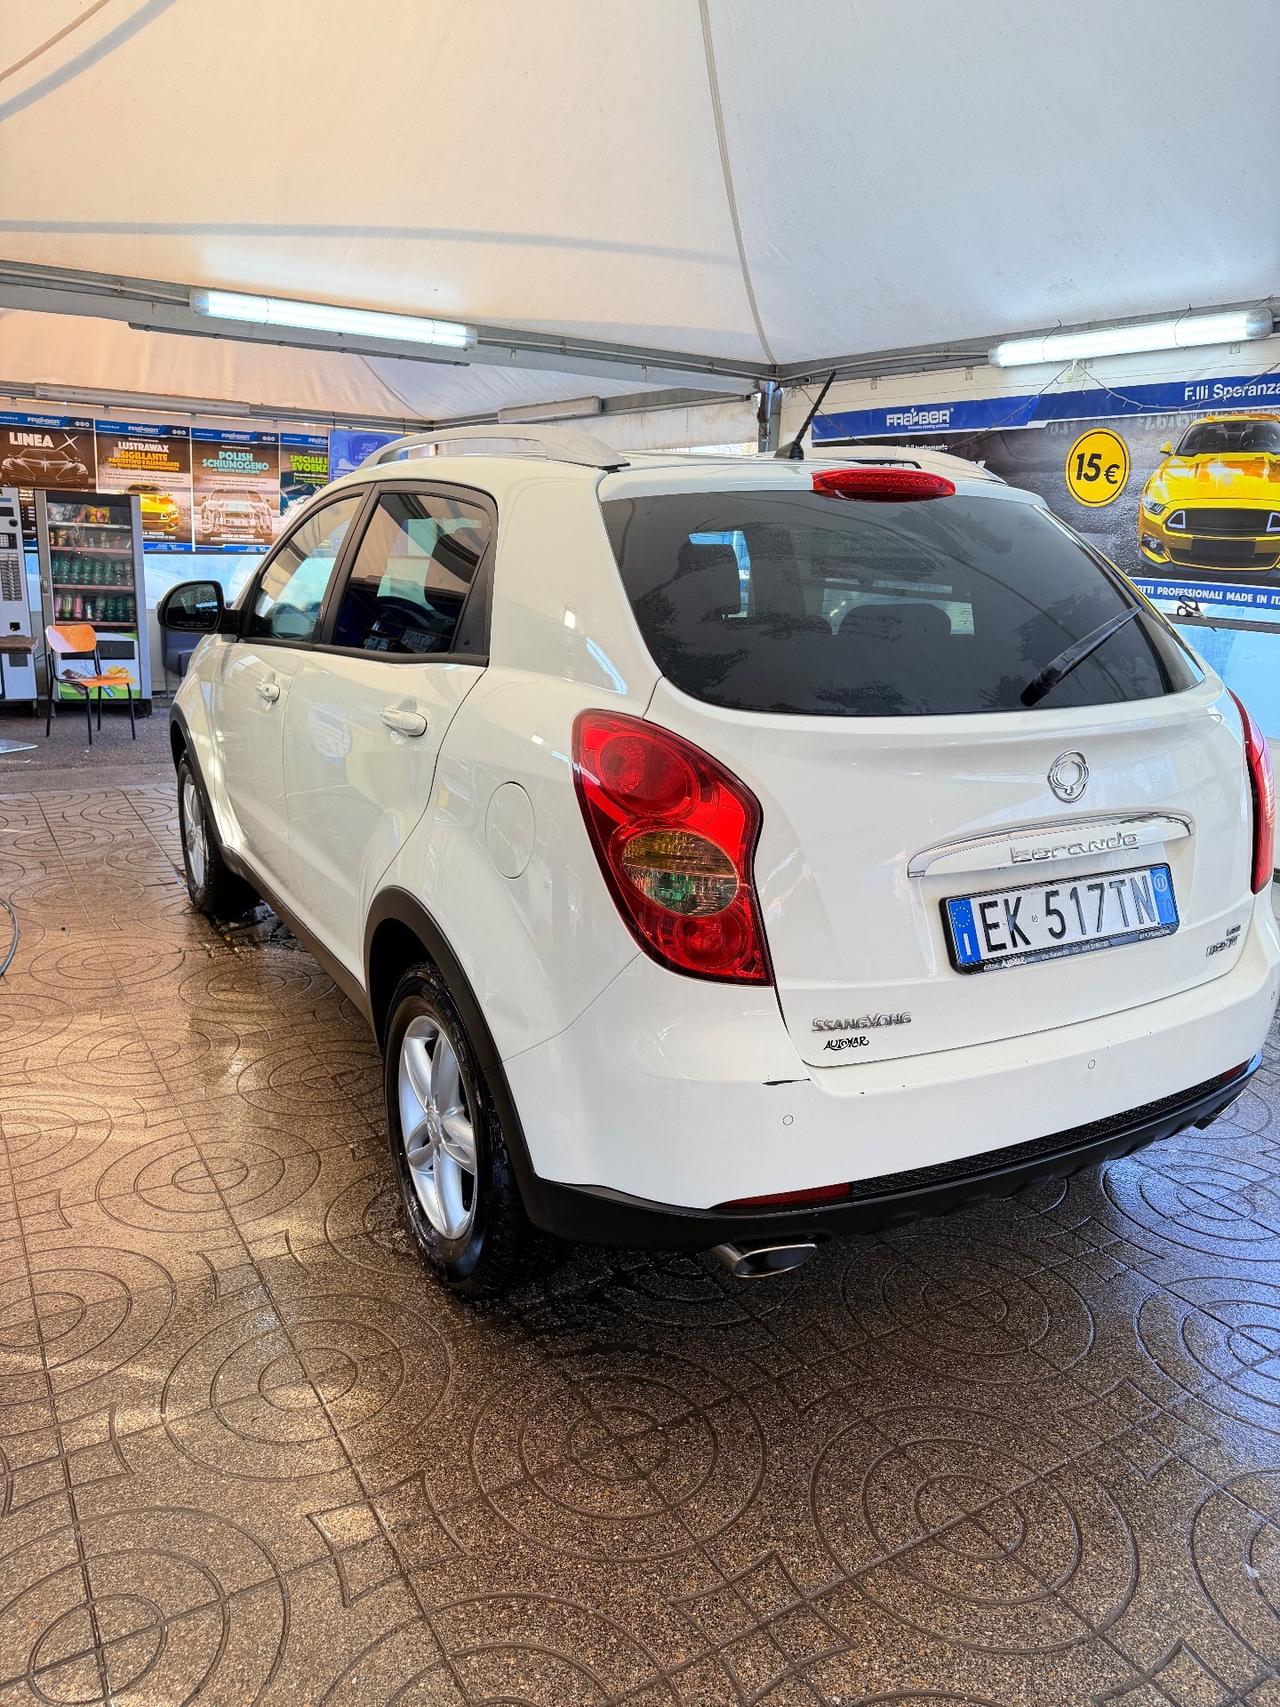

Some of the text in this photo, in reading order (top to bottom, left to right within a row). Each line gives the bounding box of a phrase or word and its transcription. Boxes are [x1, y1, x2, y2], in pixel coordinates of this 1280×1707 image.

[1213, 382, 1280, 398] Speranza
[9, 431, 55, 448] LINEA
[117, 441, 170, 453] LUSTRAWAX
[120, 450, 168, 461] SIGILLANTE
[218, 451, 254, 462] POLISH
[202, 458, 269, 471] SCHIUMOGENO
[1156, 587, 1224, 600] PROFESSIONALI
[1225, 591, 1254, 603] MADE
[1256, 593, 1269, 604] IN
[1270, 595, 1280, 605] IT
[978, 875, 1157, 953] EK 517TN
